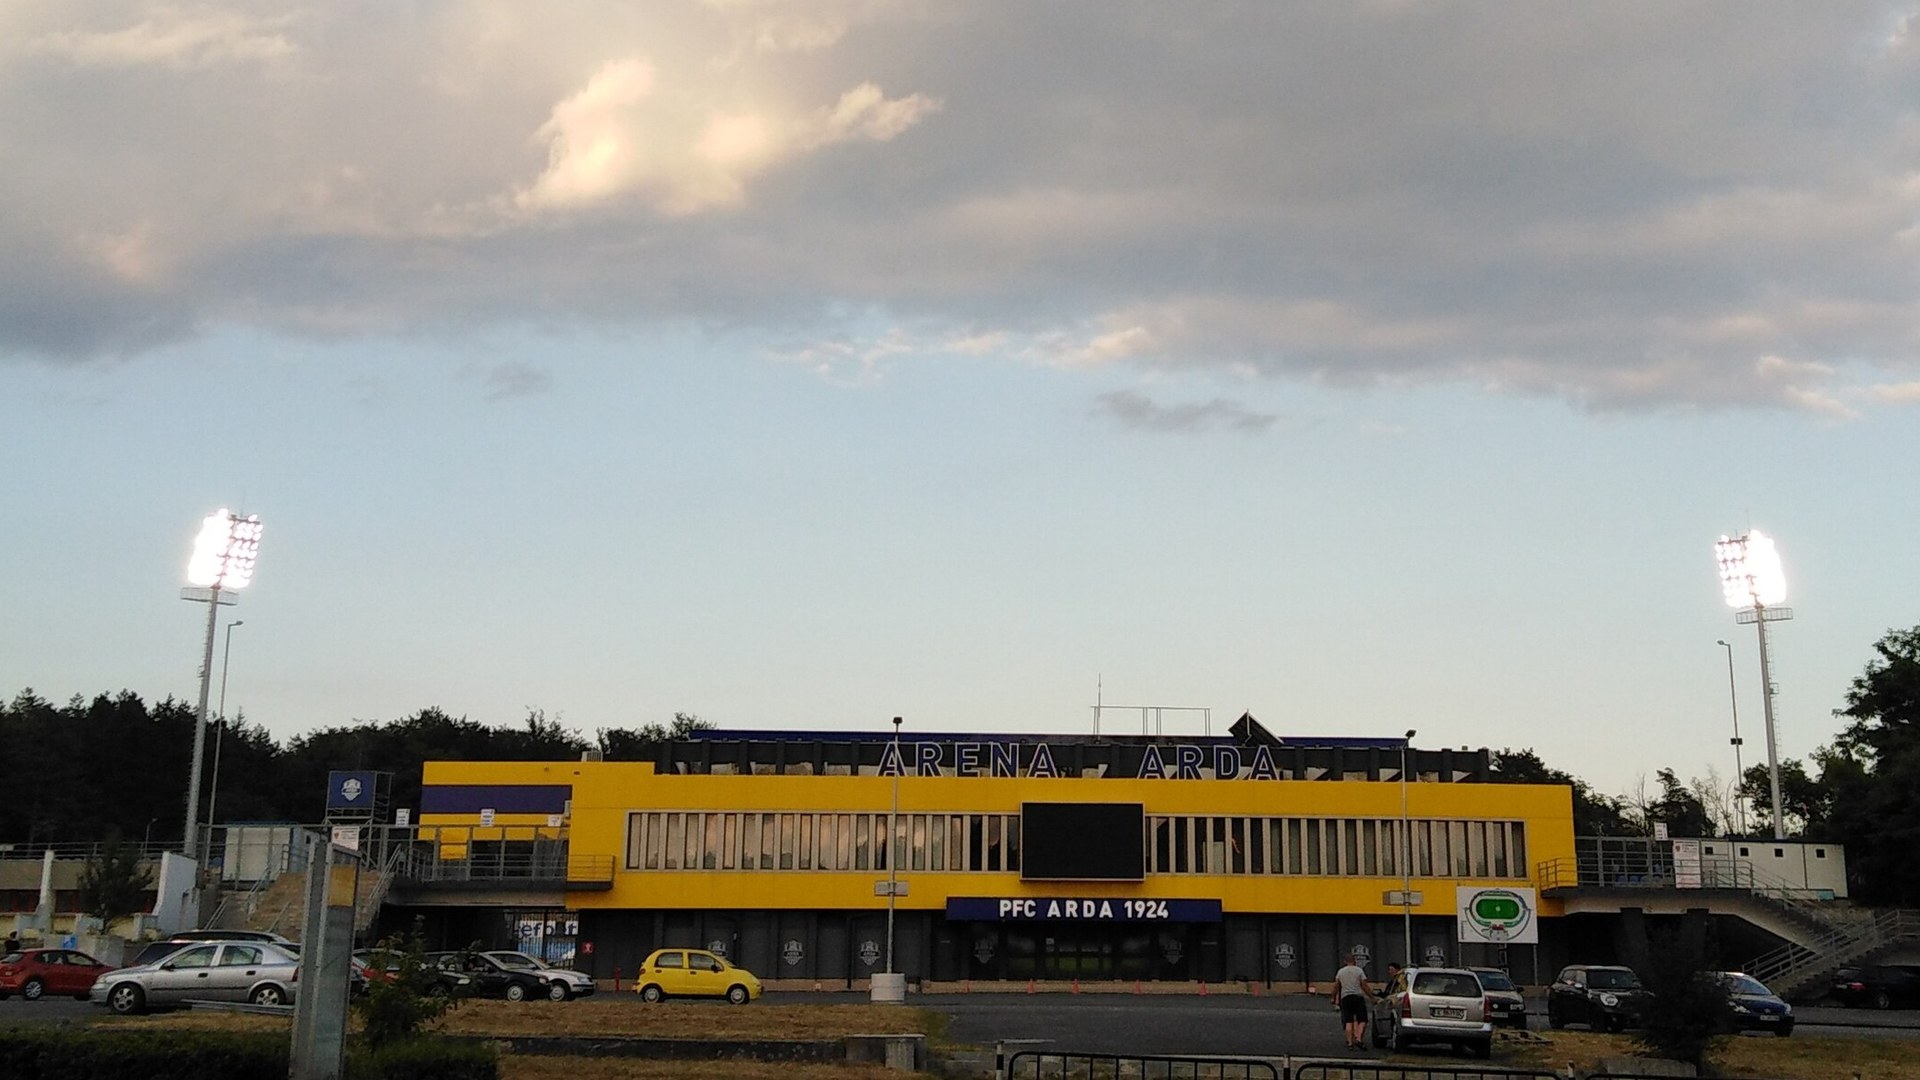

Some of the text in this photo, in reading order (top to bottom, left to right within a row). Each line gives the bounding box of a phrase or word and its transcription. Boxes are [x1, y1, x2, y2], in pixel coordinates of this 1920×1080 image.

[876, 741, 1280, 781] ARENA ARDA
[999, 900, 1169, 919] PFC ARDA 1924
